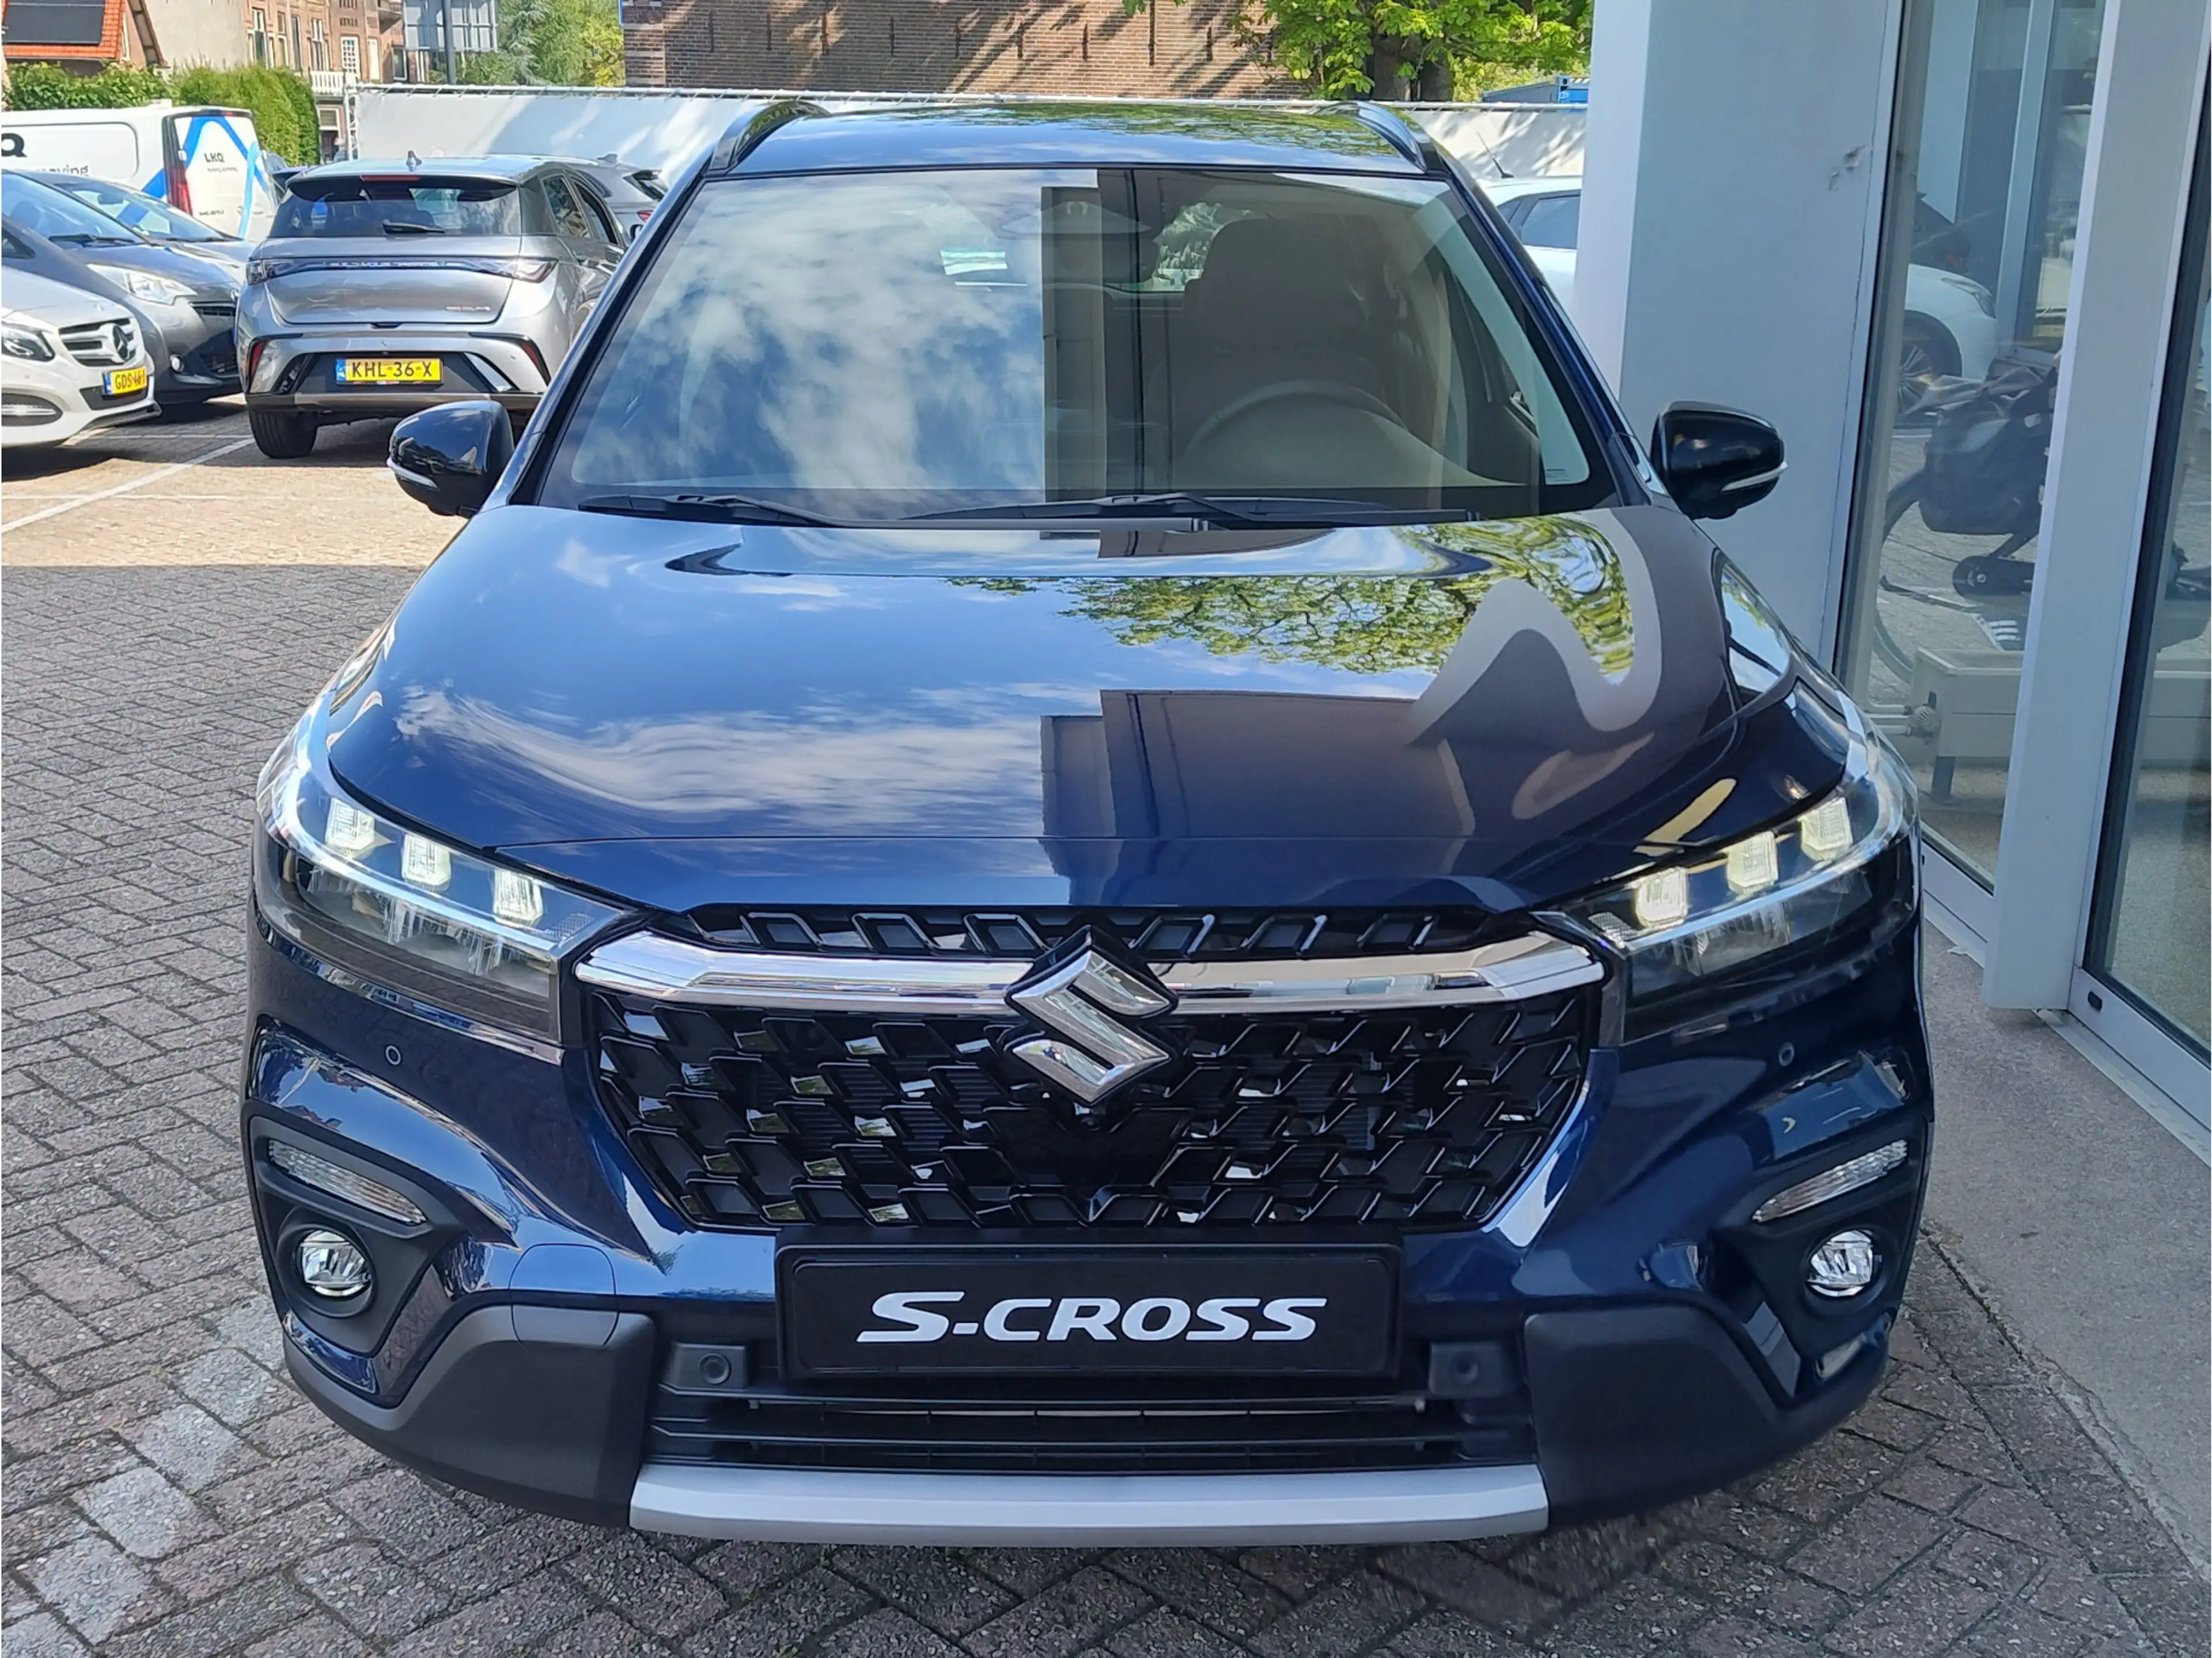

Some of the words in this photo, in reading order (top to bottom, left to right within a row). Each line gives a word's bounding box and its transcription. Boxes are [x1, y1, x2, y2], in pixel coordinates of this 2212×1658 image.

[203, 152, 225, 162] LKQ
[352, 361, 432, 377] KHL-36-X
[856, 1291, 1327, 1342] S-CROSS
